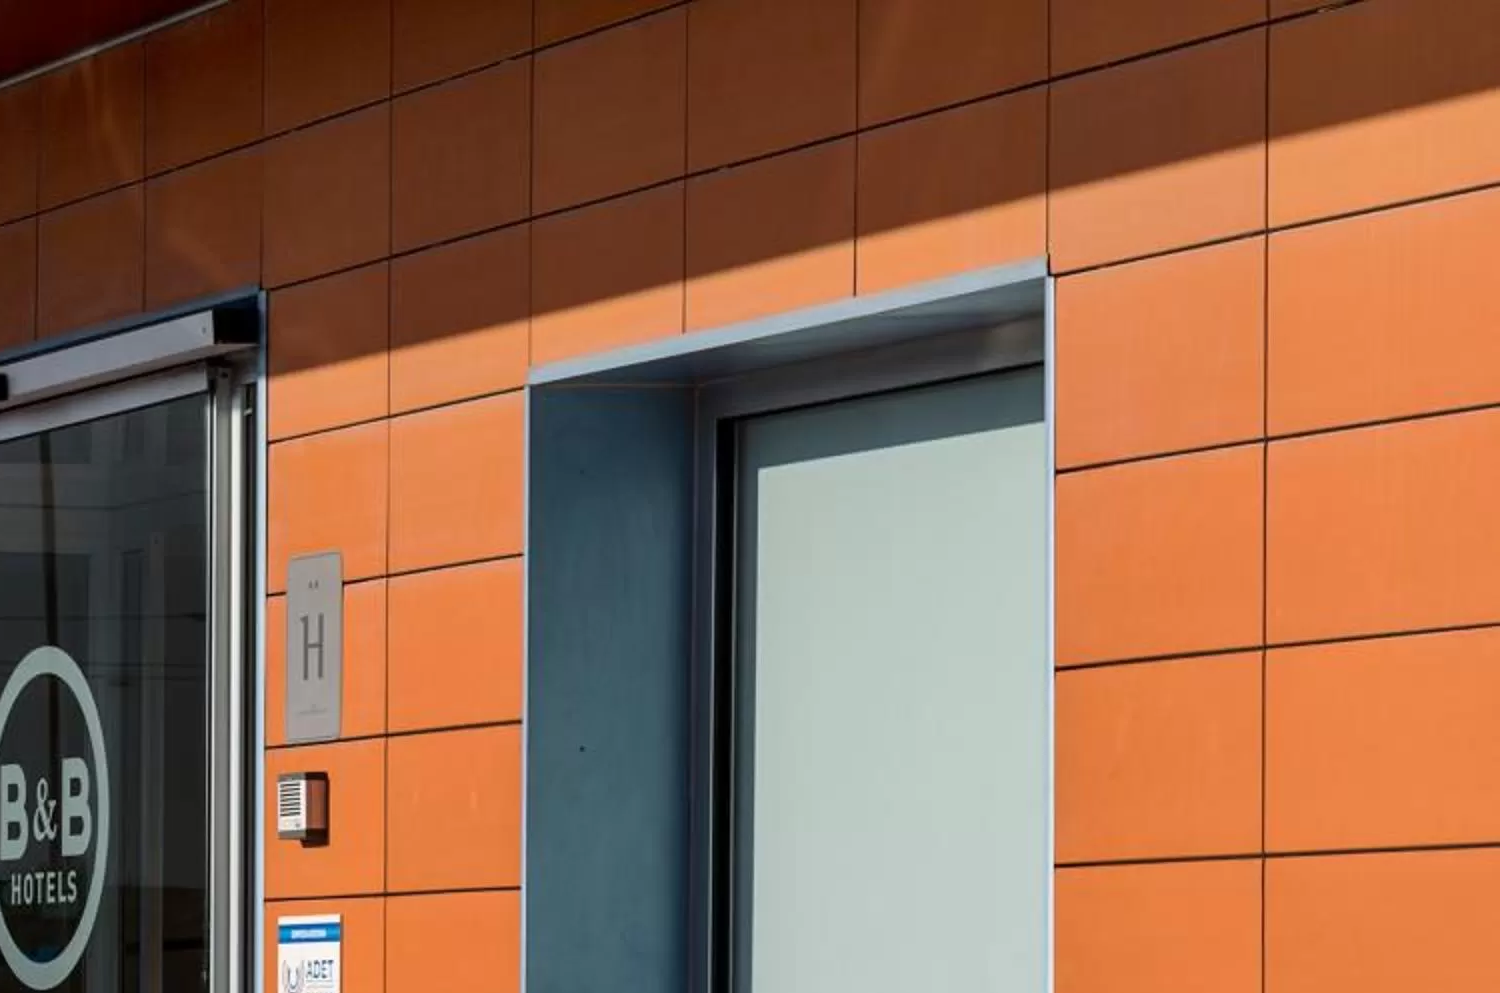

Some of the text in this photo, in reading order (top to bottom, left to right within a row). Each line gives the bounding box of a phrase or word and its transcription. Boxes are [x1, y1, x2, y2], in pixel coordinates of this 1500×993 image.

[300, 612, 324, 681] H
[0, 756, 92, 861] B&B
[11, 871, 77, 905] HOTELS
